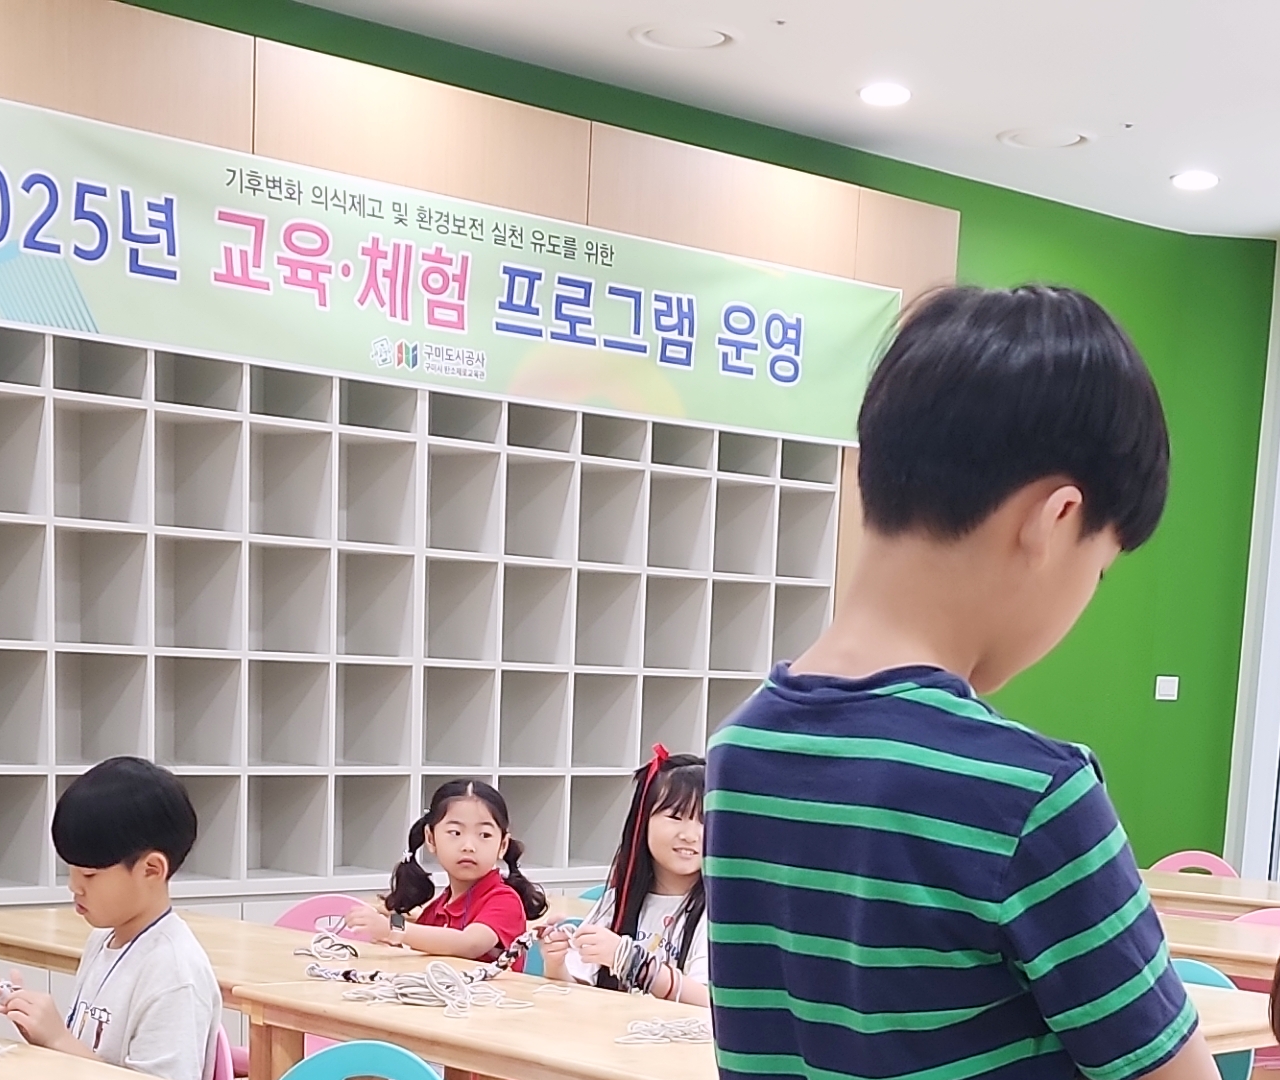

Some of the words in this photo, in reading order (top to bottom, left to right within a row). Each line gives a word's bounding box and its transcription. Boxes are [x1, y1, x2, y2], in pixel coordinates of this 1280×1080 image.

[224, 165, 304, 206] 기후변화
[310, 184, 385, 221] 의식제고
[391, 200, 410, 227] 및
[415, 205, 485, 243] 환경보전
[491, 221, 525, 250] 실천
[529, 229, 578, 261] 유도를
[583, 239, 615, 268] 위한
[213, 209, 470, 332] 교육·체험
[494, 264, 696, 368] 프로그램
[716, 304, 802, 385] 운영
[423, 343, 486, 368] 구미도시공사
